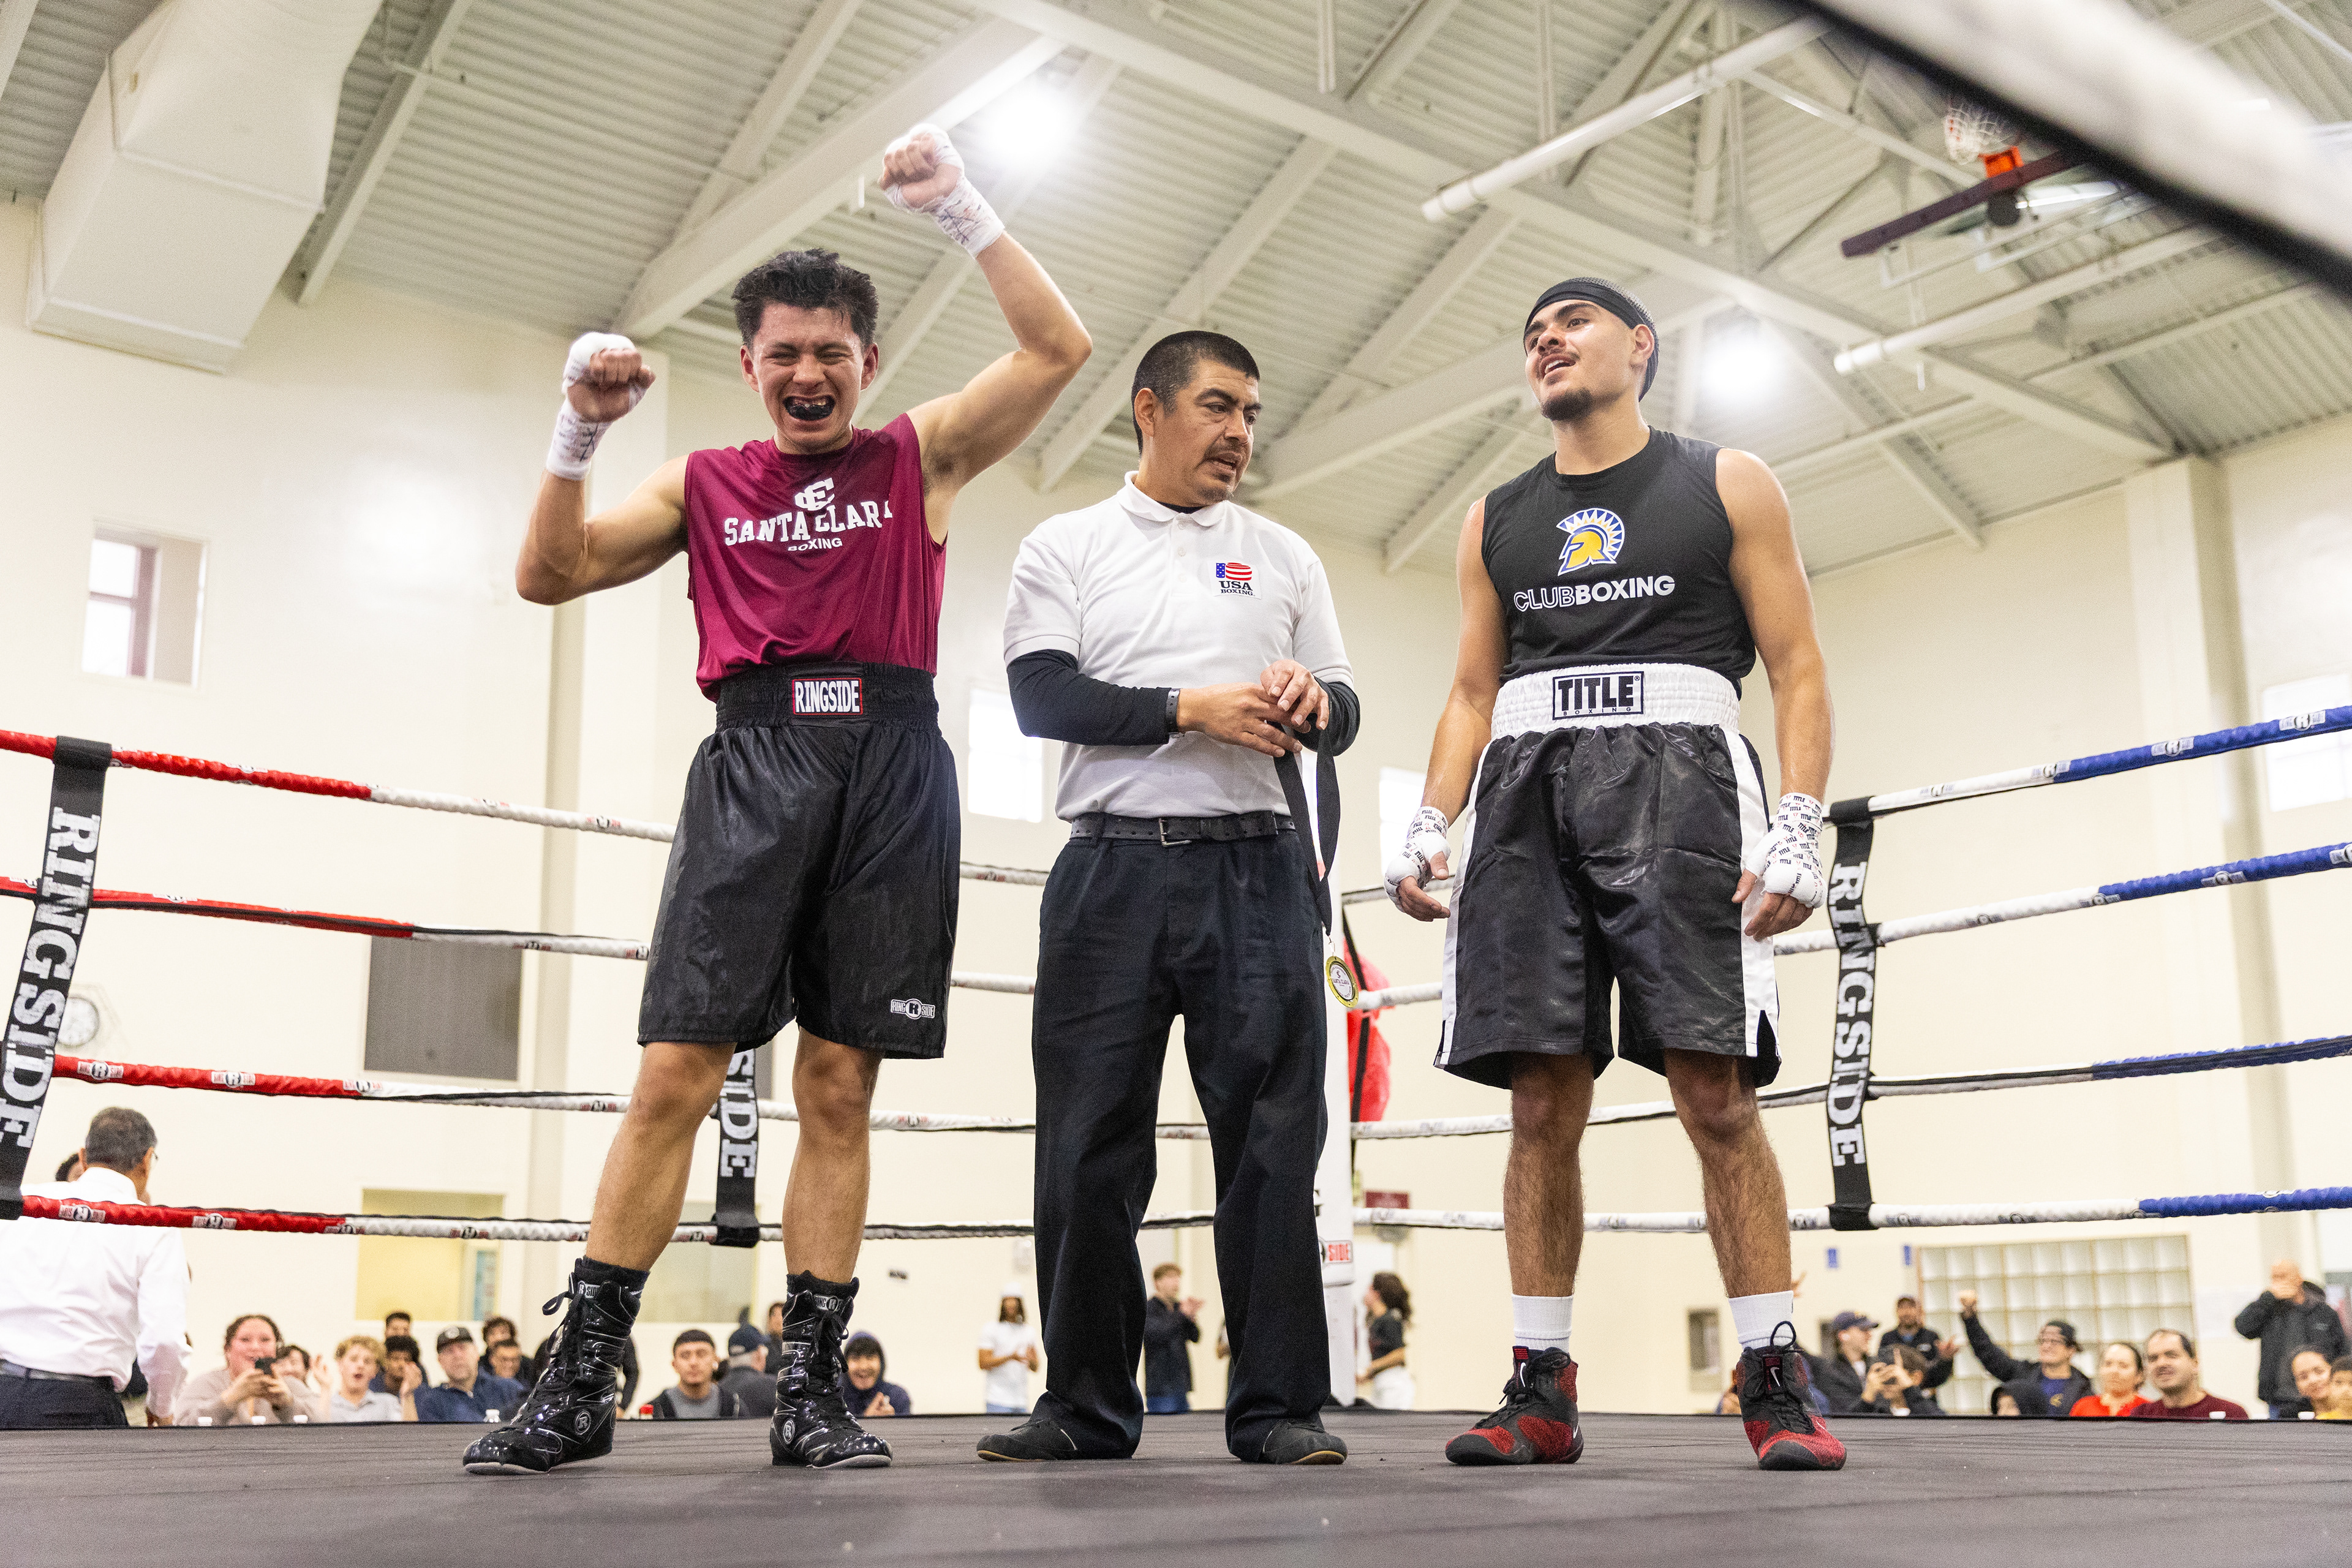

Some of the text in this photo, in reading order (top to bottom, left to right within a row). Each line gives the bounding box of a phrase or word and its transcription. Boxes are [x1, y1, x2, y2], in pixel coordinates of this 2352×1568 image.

[725, 511, 810, 546] SANTA
[788, 537, 843, 551] BOXING
[1219, 581, 1253, 591] USA
[795, 680, 860, 713] RINGSIDE
[1558, 676, 1634, 711] TITLE
[1563, 707, 1631, 716] BOXING
[1782, 824, 1795, 833] TITLE
[1779, 846, 1791, 856] TITLE
[0, 807, 101, 1148] RINGSIDE
[892, 1001, 933, 1017] RING R SIDE
[1828, 861, 1874, 1166] RINGSIDE
[1328, 1243, 1349, 1261] SIDE
[586, 1286, 598, 1297] SID
[578, 1416, 588, 1429] R
